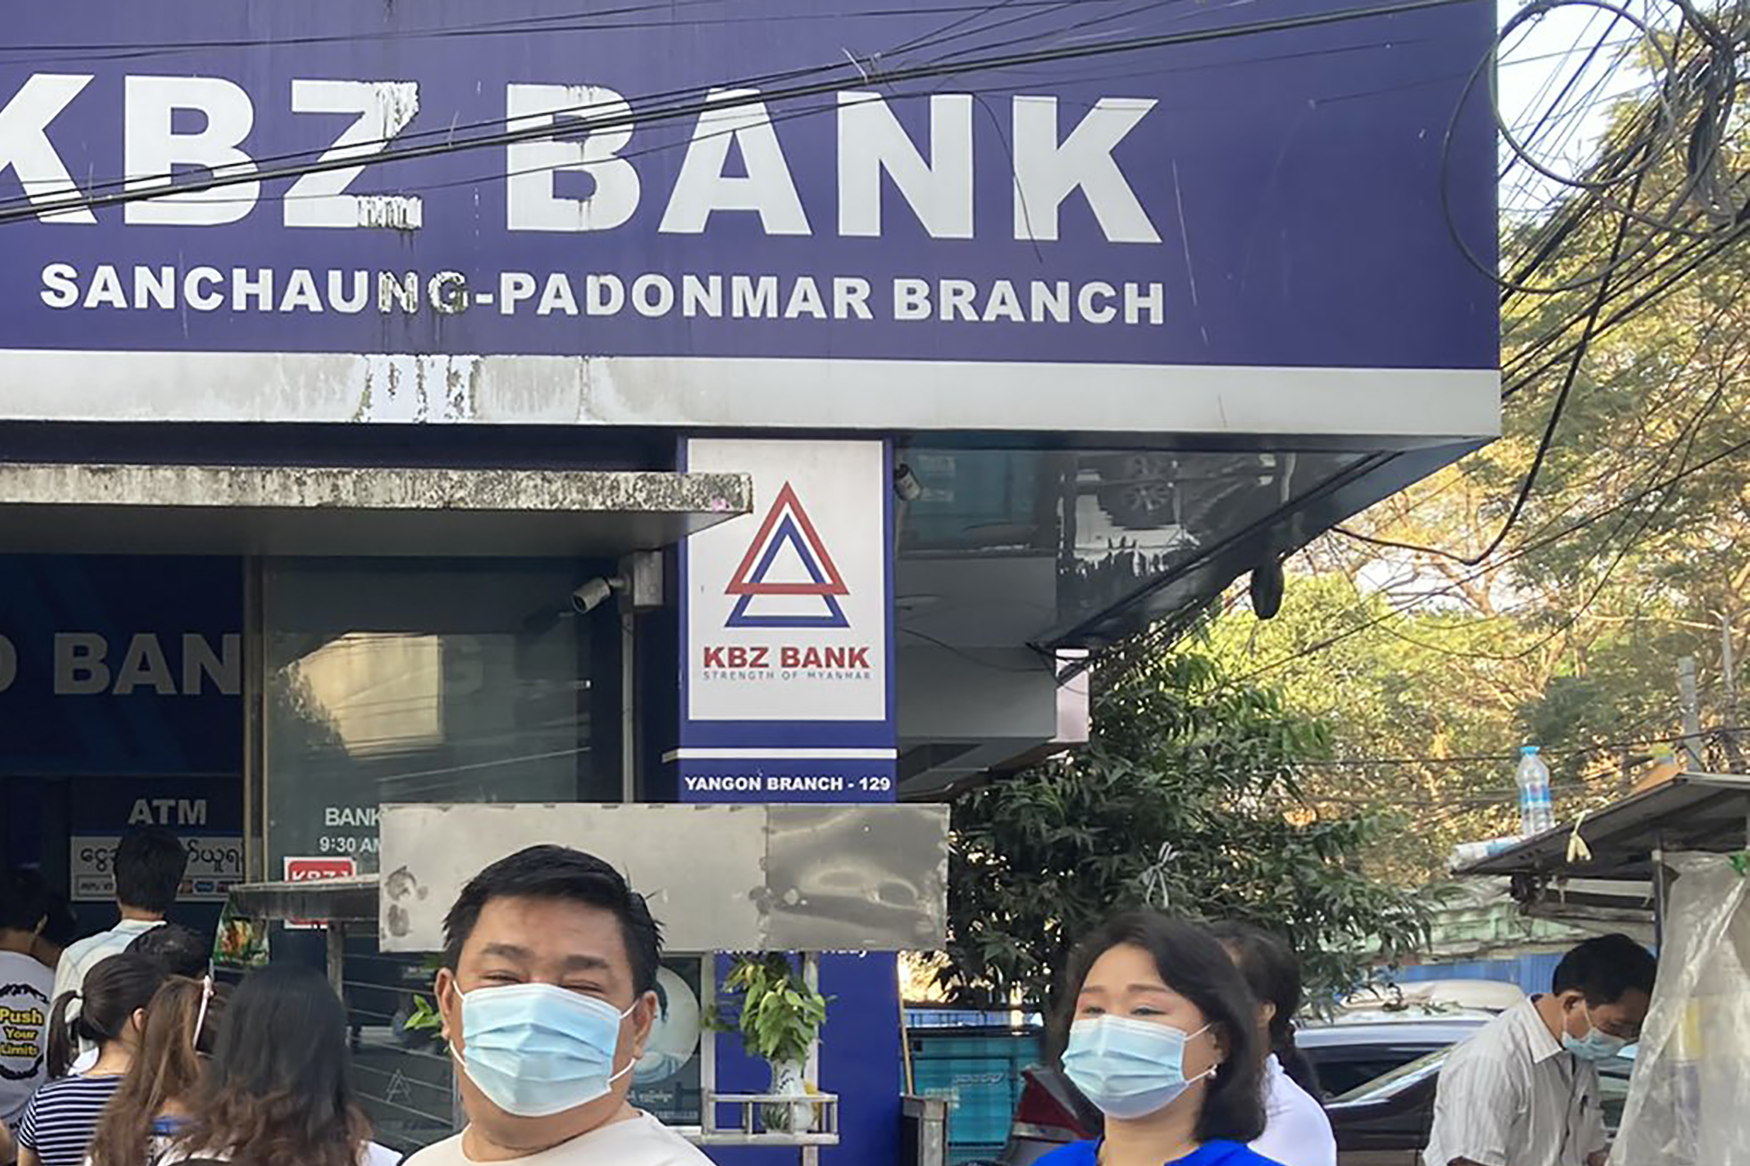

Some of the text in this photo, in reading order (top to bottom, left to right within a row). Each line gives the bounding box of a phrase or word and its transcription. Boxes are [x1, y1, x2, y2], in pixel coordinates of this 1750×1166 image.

[507, 83, 1163, 243] BANK
[40, 263, 1164, 325] SANCHAUNG-PADONMAR BRANCH
[54, 632, 242, 696] BAN
[703, 646, 871, 669] KBZ BANK
[703, 671, 872, 681] STRENGTH OF MYANMAR
[684, 776, 762, 791] YANGON
[767, 776, 843, 791] BRANCH
[859, 776, 891, 791] 129
[128, 799, 208, 826] ATM
[319, 836, 356, 852] 9:30
[3, 1026, 38, 1040] Your
